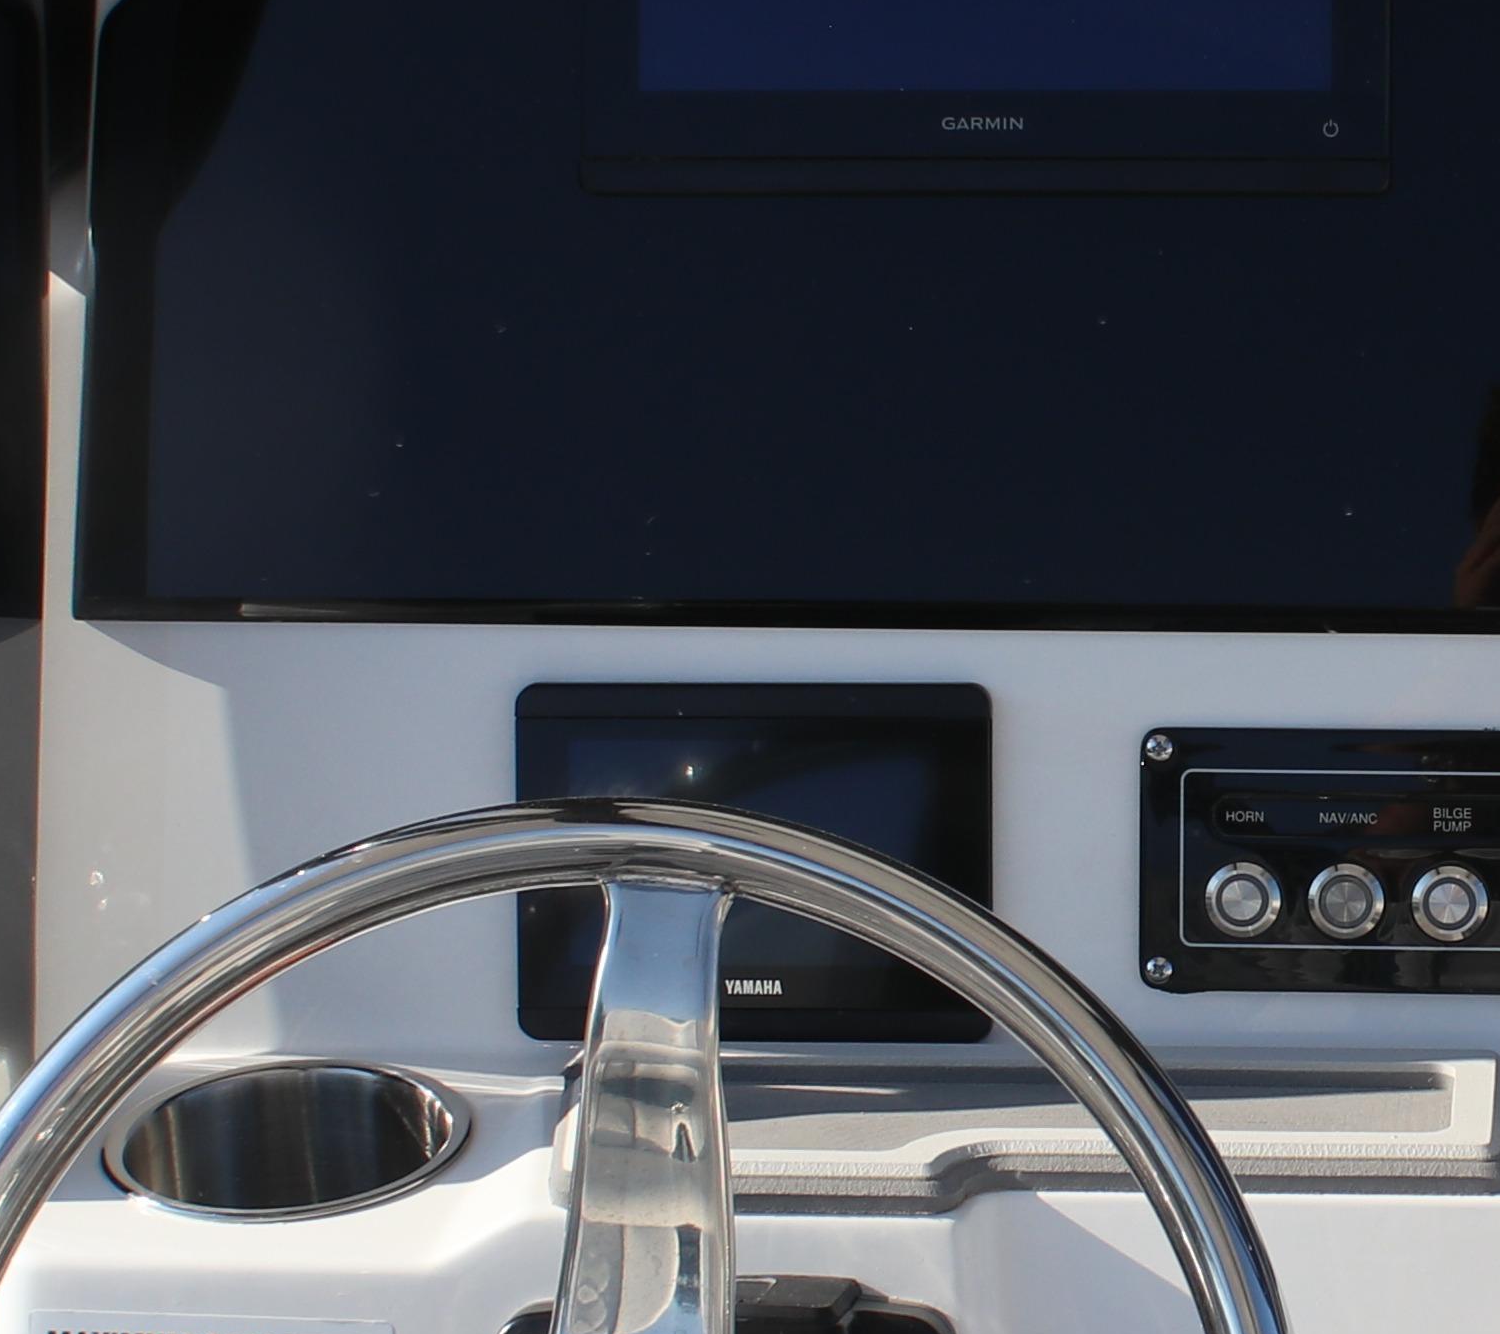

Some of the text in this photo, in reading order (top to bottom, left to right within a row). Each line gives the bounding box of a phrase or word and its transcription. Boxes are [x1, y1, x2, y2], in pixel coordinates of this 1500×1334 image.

[941, 116, 1025, 132] GARMIN
[1226, 811, 1264, 823] HORN
[1319, 812, 1378, 825] NAV/ANC
[1433, 807, 1472, 819] BILGE
[1433, 820, 1472, 832] PUMP
[725, 979, 783, 996] YAMAHA
